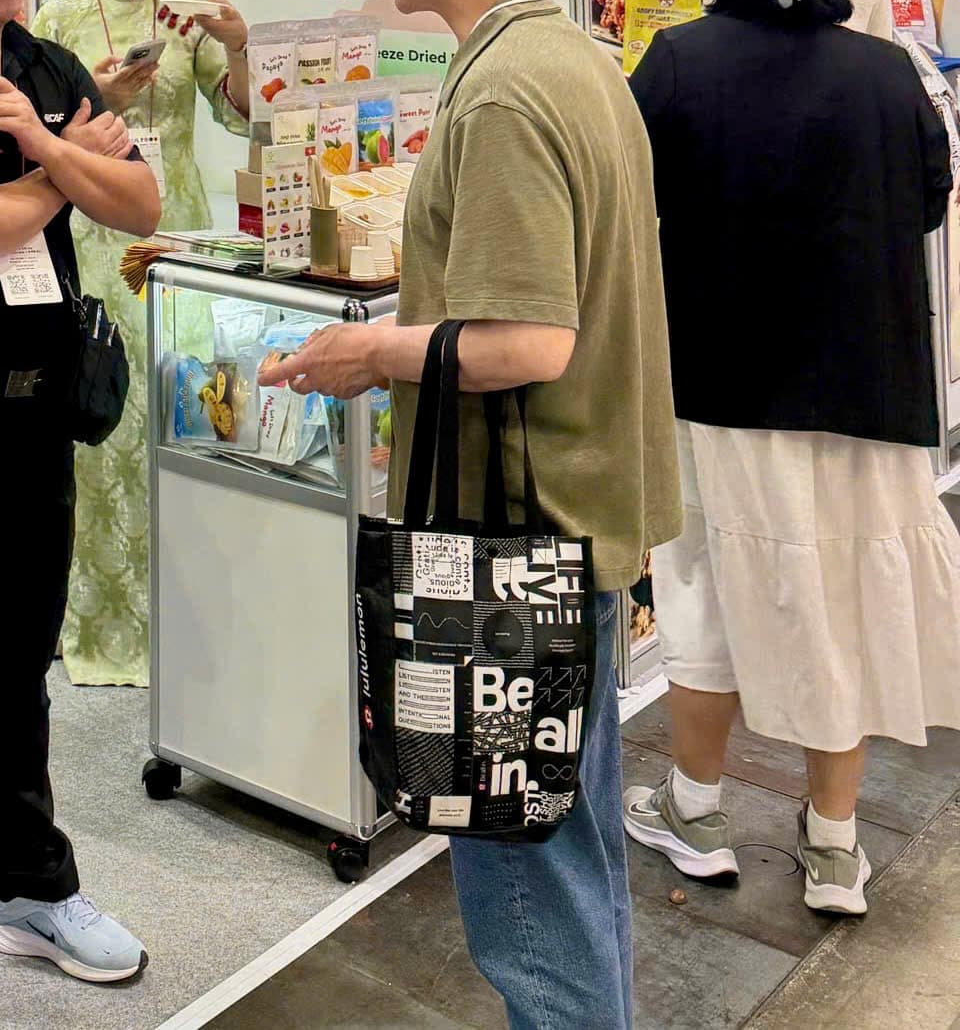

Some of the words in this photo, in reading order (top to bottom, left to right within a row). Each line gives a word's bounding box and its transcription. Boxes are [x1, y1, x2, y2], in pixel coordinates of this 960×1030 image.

[378, 50, 404, 61] eze
[408, 50, 447, 64] Dried
[355, 592, 372, 698] lululemon
[473, 665, 534, 713] Be
